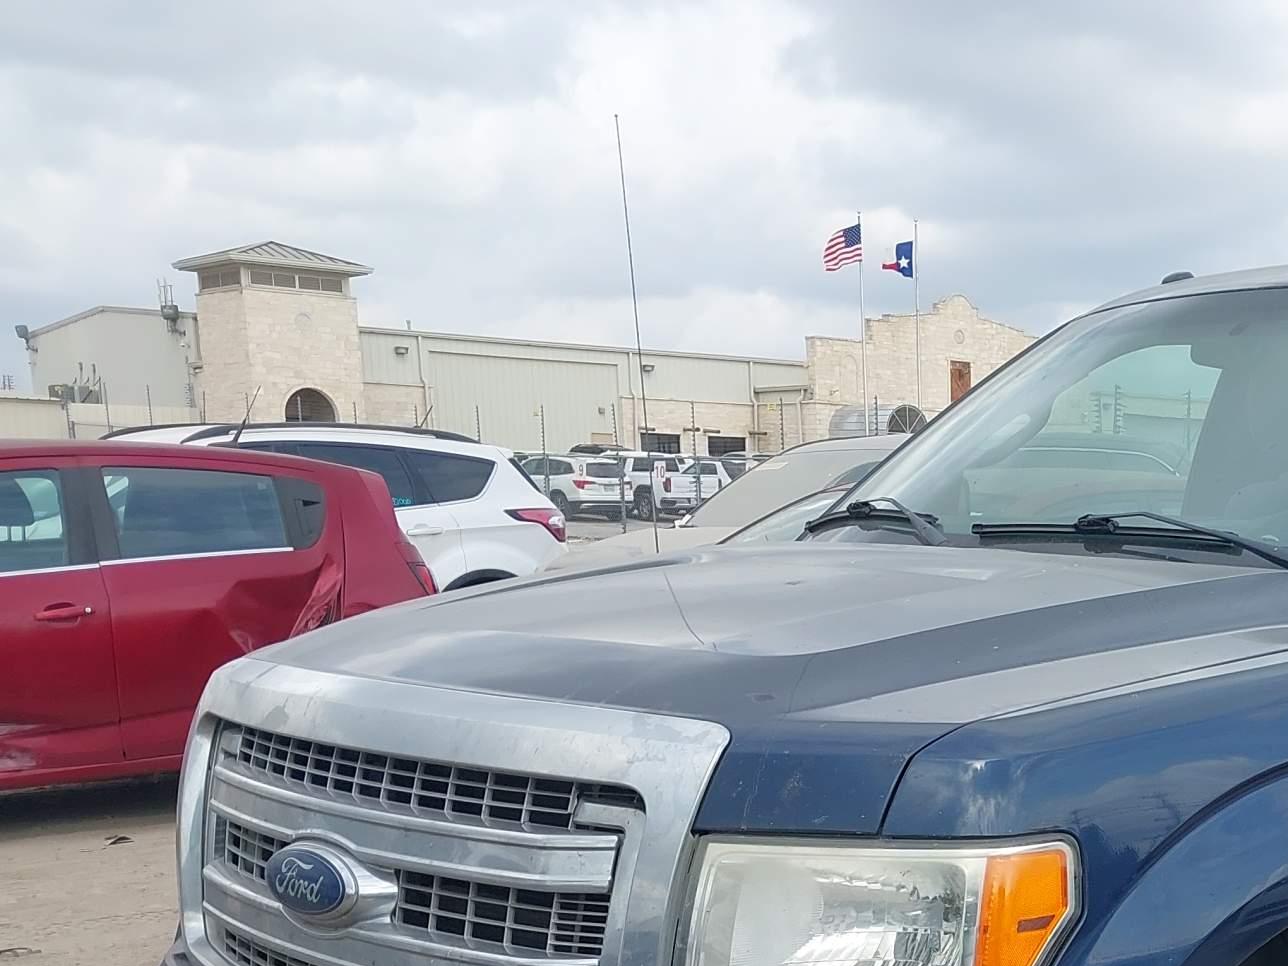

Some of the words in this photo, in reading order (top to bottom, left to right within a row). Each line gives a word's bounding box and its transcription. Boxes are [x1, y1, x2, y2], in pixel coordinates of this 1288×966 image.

[578, 464, 585, 477] 9
[655, 465, 665, 479] 10
[275, 856, 325, 904] Ford
